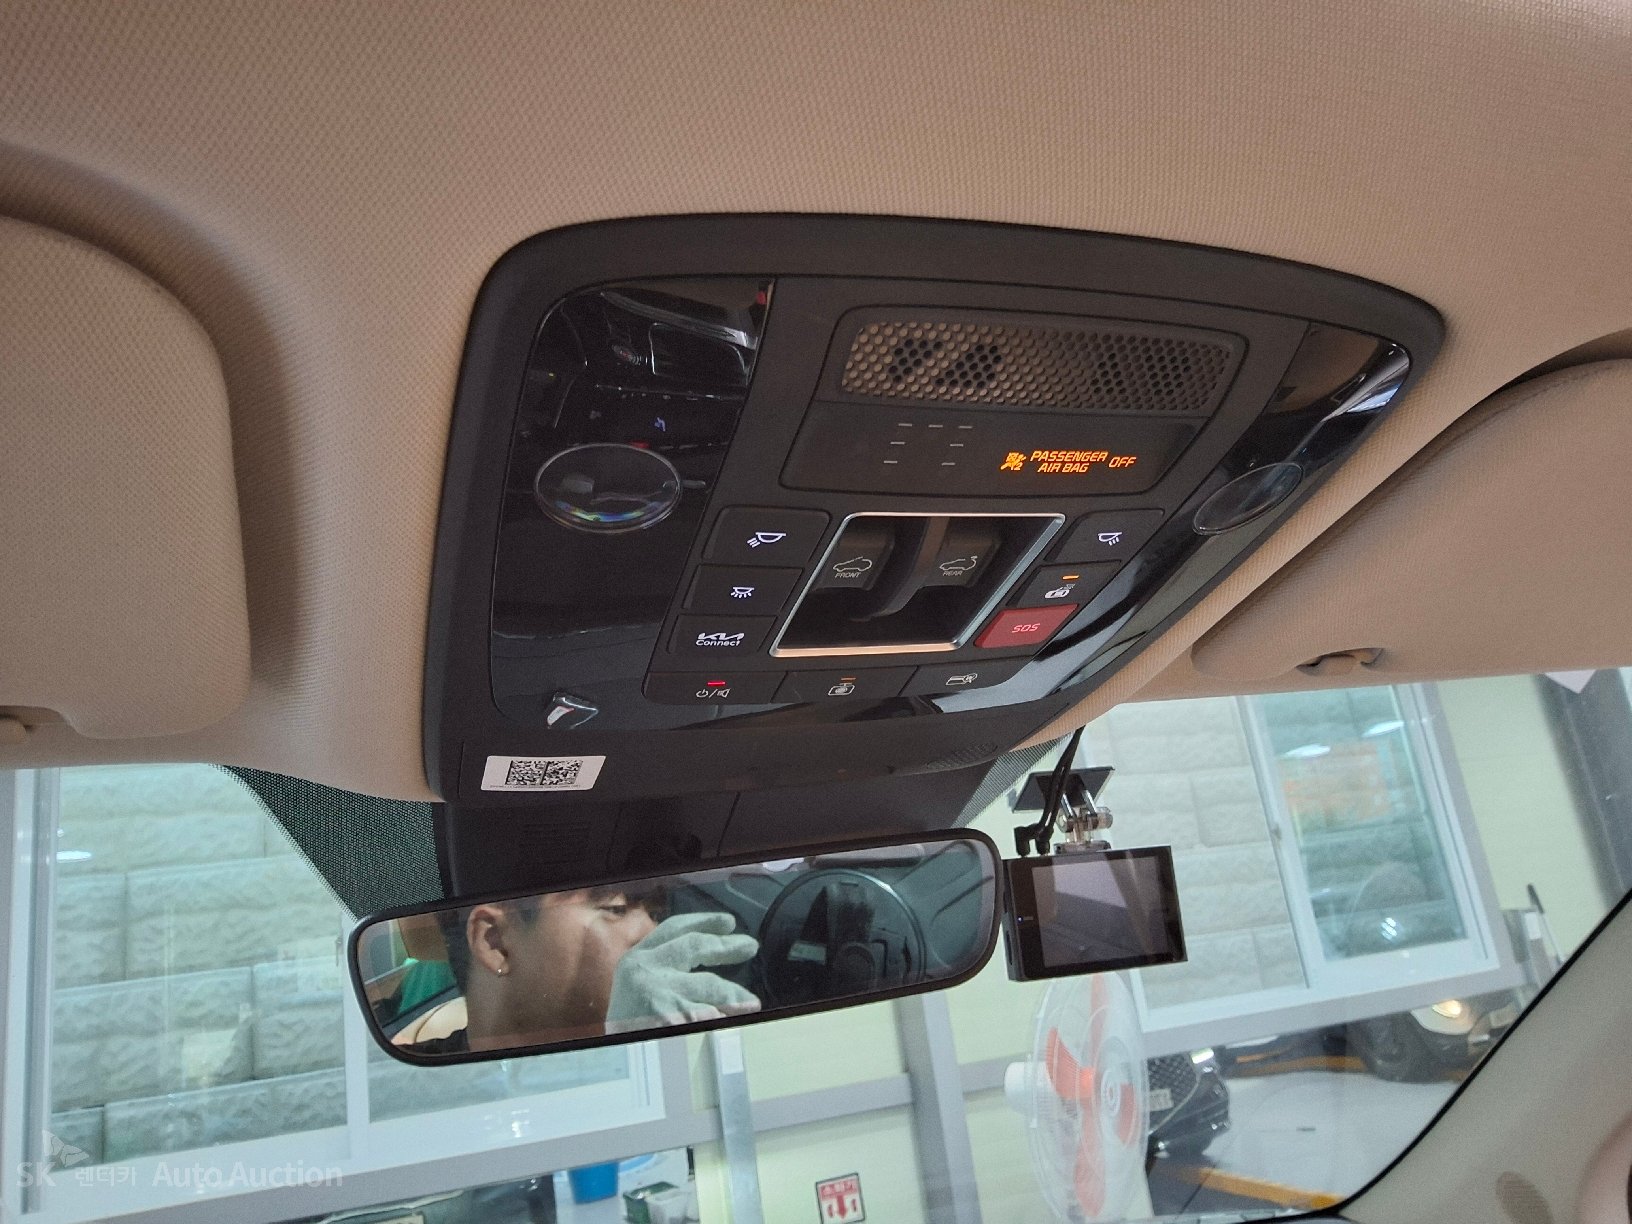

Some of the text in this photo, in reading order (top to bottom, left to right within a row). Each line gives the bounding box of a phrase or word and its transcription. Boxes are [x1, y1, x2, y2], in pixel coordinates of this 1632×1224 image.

[1030, 450, 1108, 462] PASSENGER
[1037, 462, 1090, 473] AIR BAG
[1108, 456, 1137, 468] OFF
[1011, 623, 1041, 633] SOS
[695, 639, 741, 647] Connect
